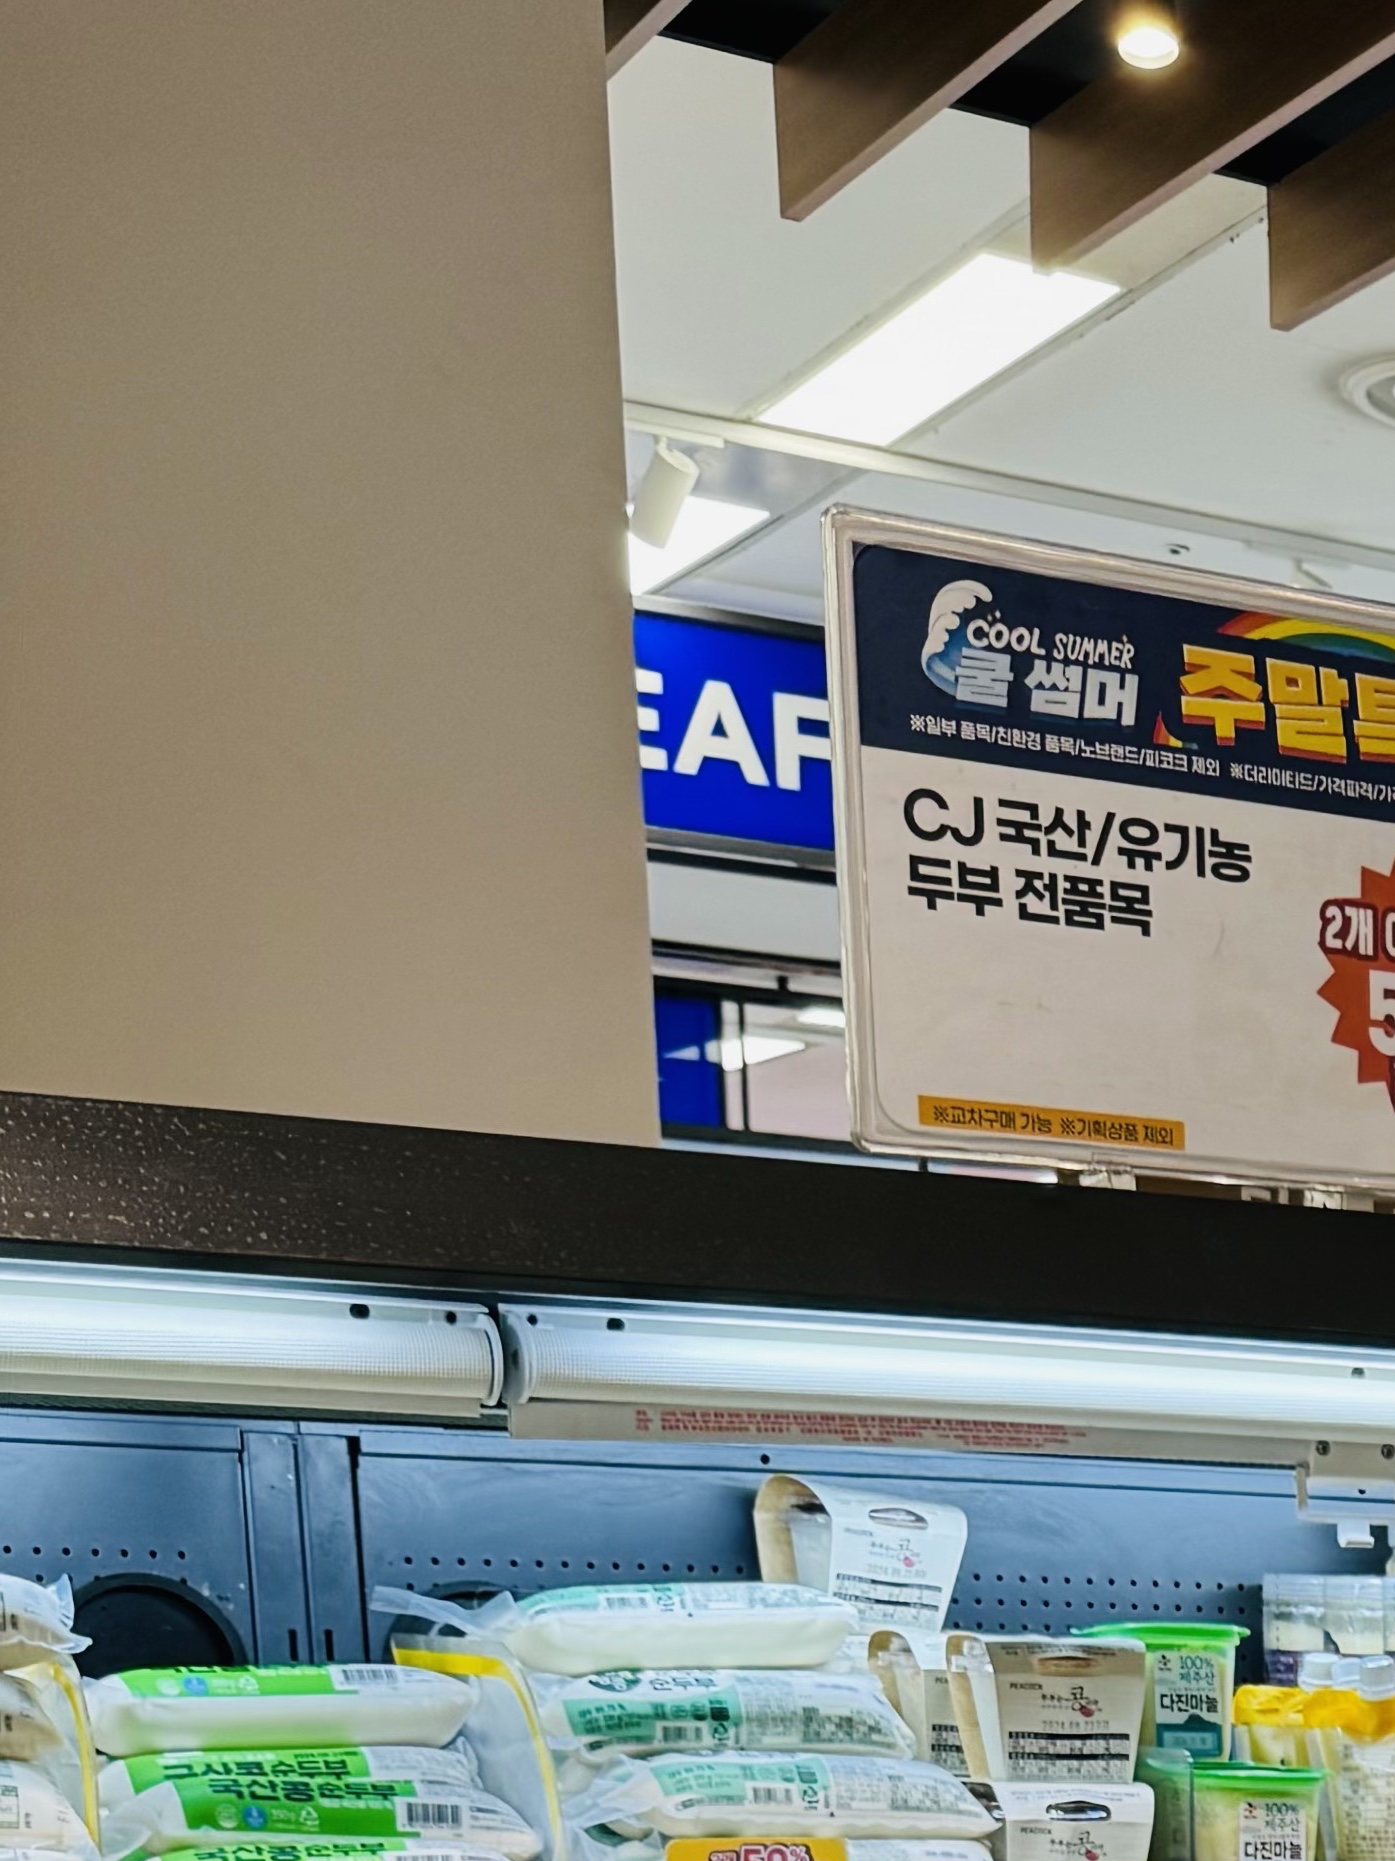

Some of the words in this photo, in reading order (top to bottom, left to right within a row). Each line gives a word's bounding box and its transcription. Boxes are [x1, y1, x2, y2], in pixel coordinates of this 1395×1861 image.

[966, 618, 1046, 656] COOL
[1053, 633, 1136, 669] SUMMER
[955, 647, 1014, 708] 쿨
[1024, 659, 1140, 727] 썸머
[1191, 756, 1221, 778] 제외
[903, 787, 985, 847] CJ
[996, 798, 1253, 883] 국산/유기농
[907, 854, 1004, 917] 두부
[1015, 868, 1154, 938] 전품목
[1324, 905, 1374, 956] 2개
[1021, 1112, 1053, 1134] 가능
[1143, 1125, 1174, 1146] 제외
[1160, 1692, 1219, 1713] 다진마늘
[208, 1777, 399, 1804] 국산콩순두부
[1243, 1840, 1303, 1861] 다진마늘
